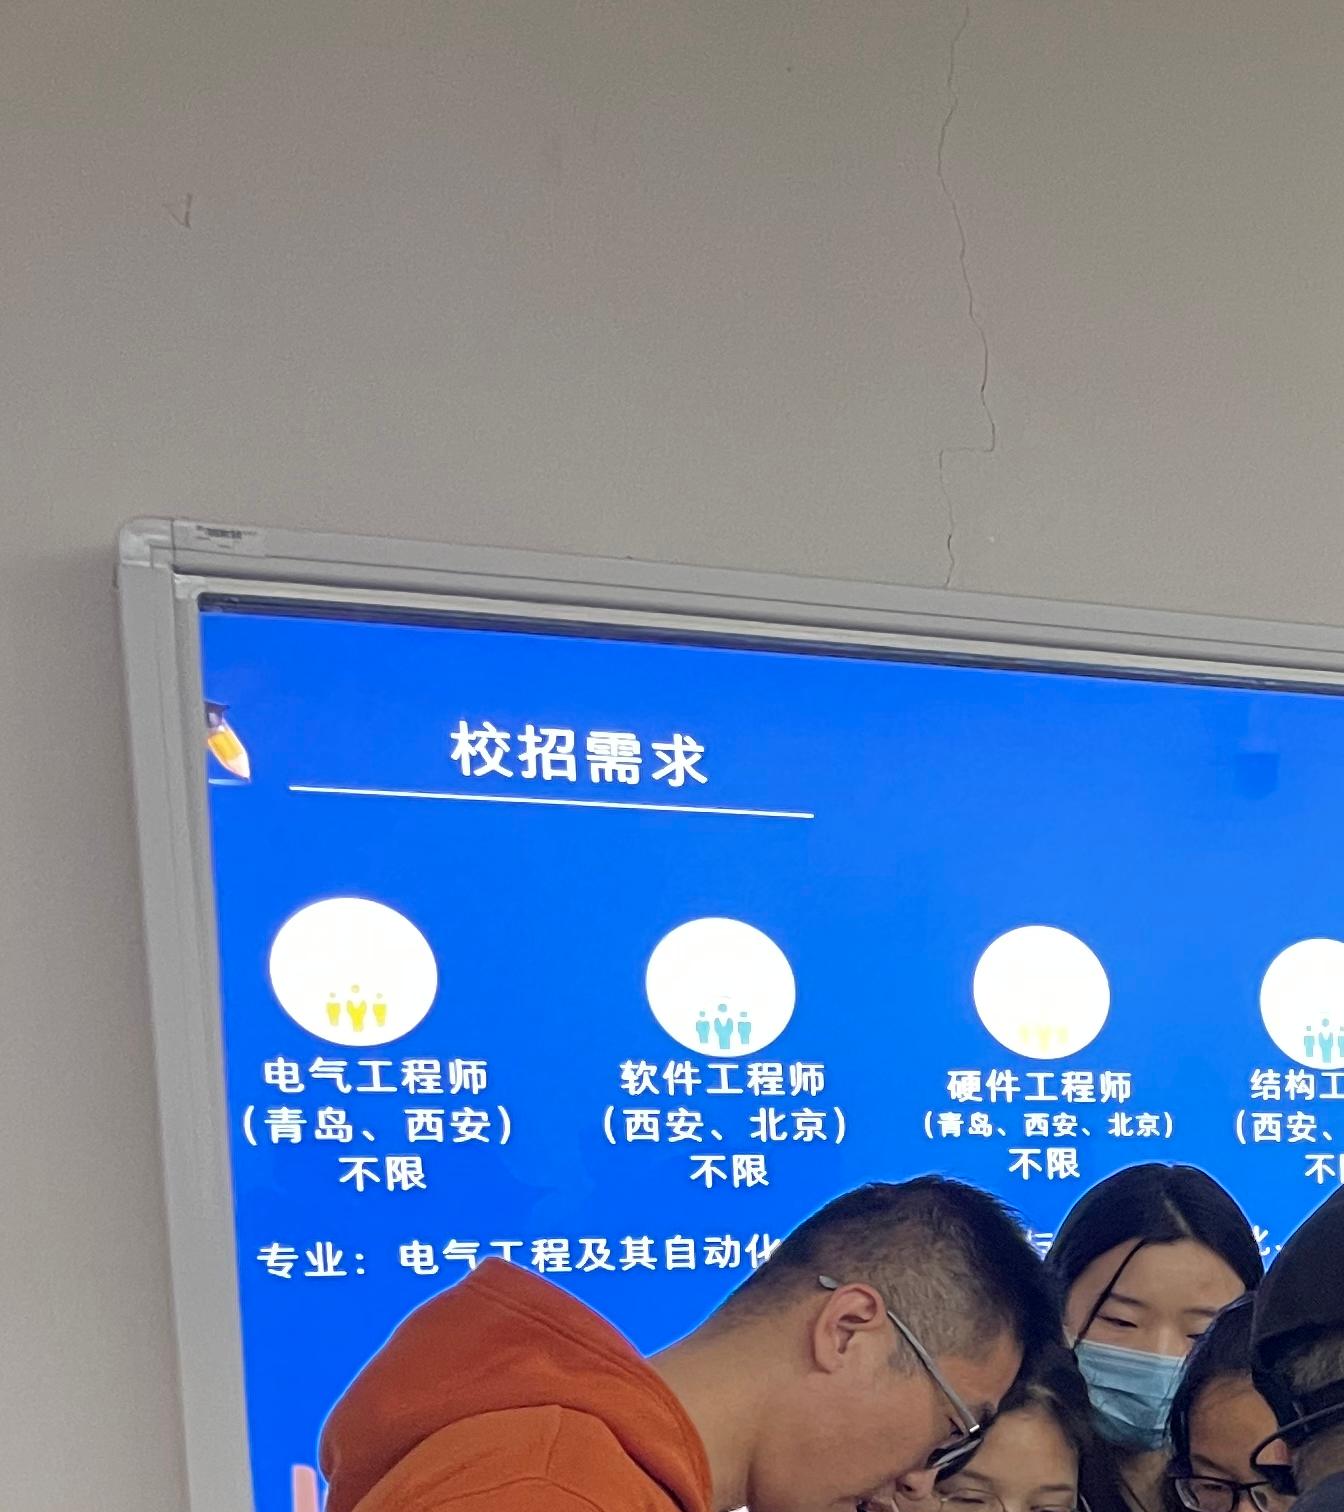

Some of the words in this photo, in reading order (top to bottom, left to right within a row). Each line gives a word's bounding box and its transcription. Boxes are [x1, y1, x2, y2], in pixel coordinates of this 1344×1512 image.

[450, 720, 709, 788] 校招需求
[264, 1055, 488, 1095] 电气工程师
[619, 1059, 826, 1098] 软件工程师
[946, 1068, 1132, 1104] 硬件工程师
[242, 1105, 513, 1147] （青岛、西安）
[603, 1105, 847, 1146] （西安、北京）
[923, 1110, 1174, 1140] （青岛、西安、北京）
[337, 1155, 428, 1193] 不限
[689, 1153, 771, 1190] 不限
[1007, 1147, 1082, 1180] 不限
